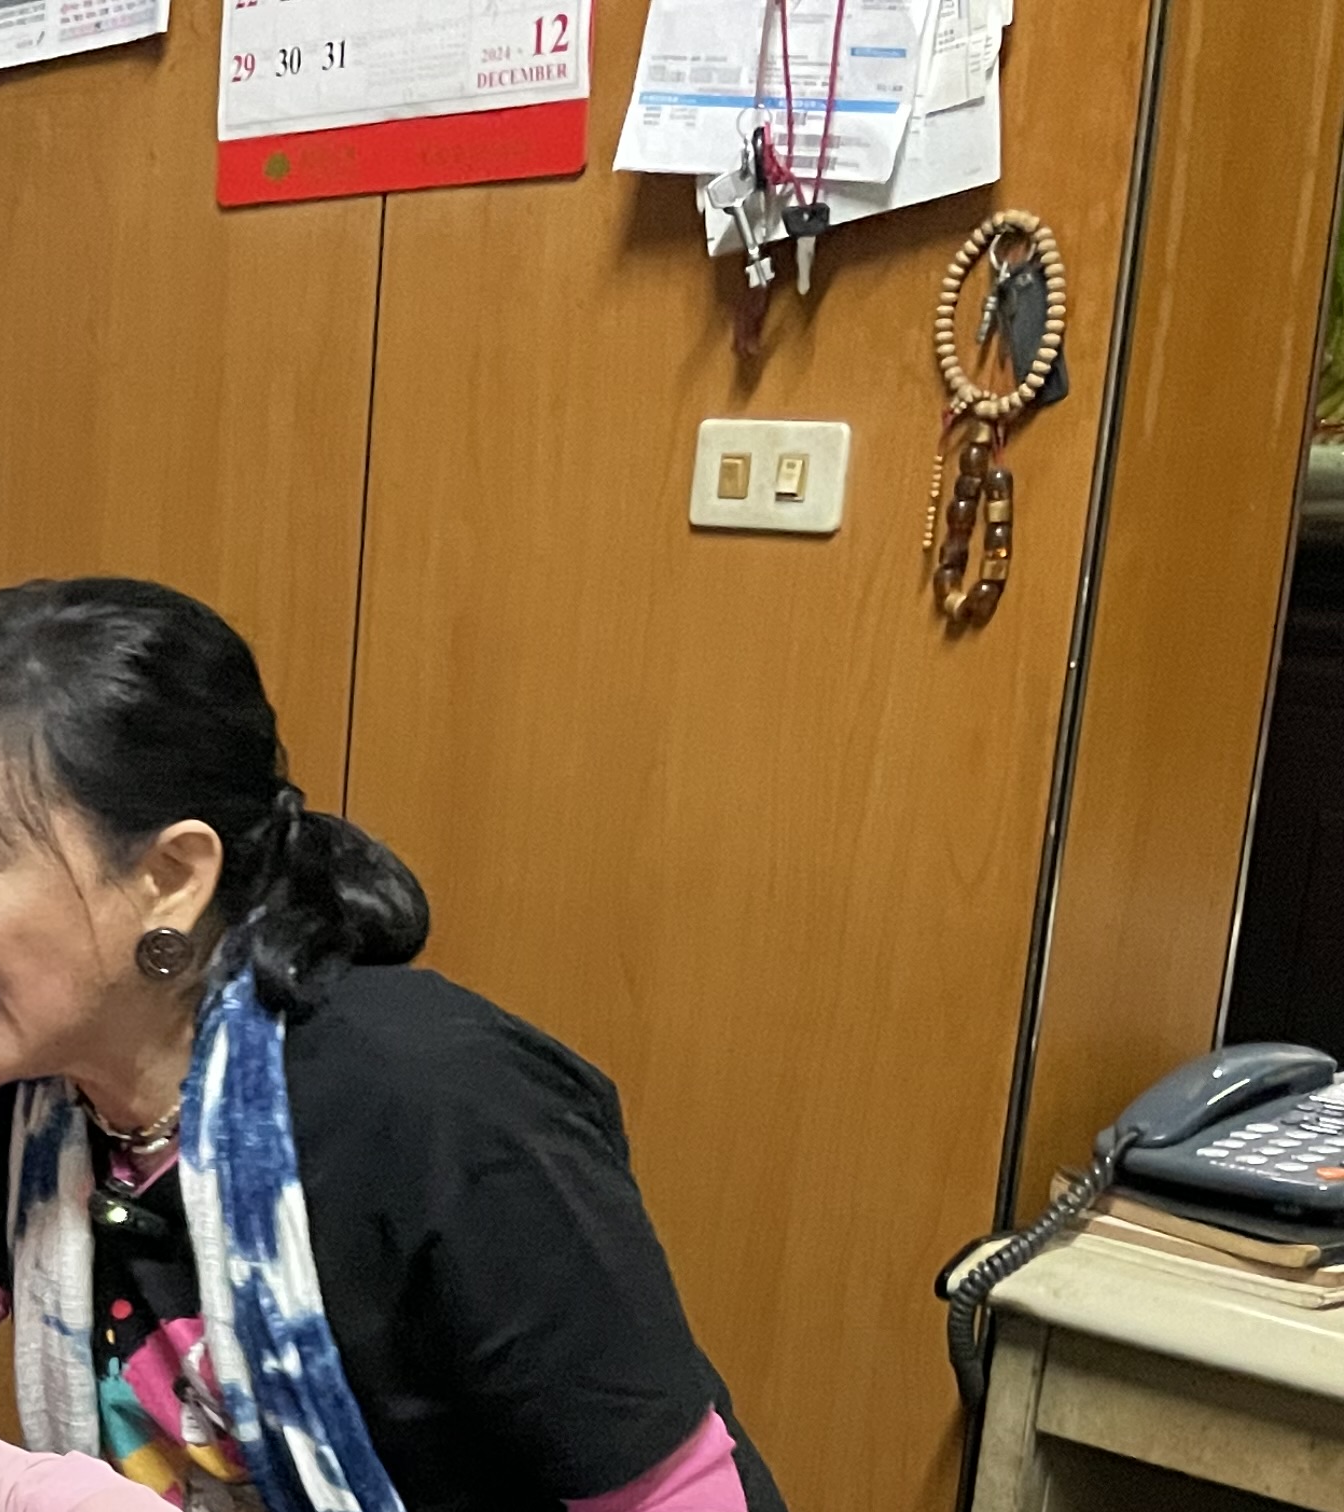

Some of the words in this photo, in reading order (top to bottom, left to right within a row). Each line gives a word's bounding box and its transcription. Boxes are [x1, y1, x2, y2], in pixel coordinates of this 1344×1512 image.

[481, 45, 511, 64] 2024
[532, 13, 570, 57] 12
[231, 53, 256, 83] 29
[275, 46, 302, 77] 30
[322, 40, 346, 71] 31
[477, 63, 568, 89] DECEMBER
